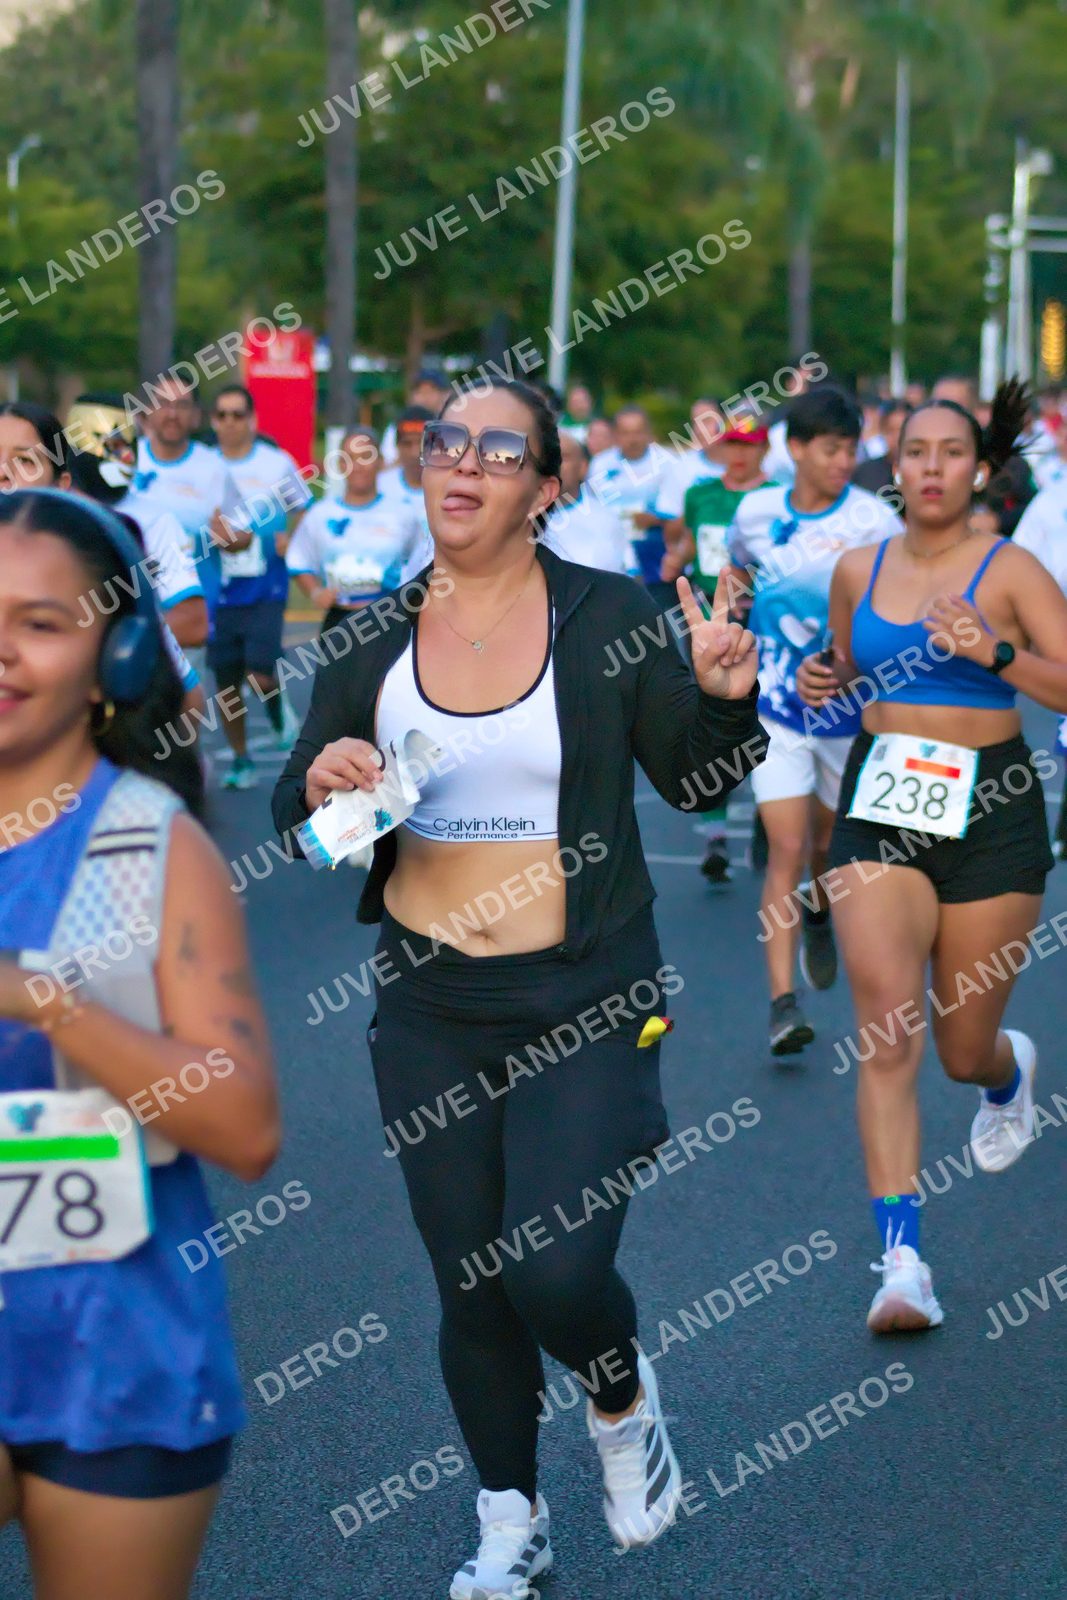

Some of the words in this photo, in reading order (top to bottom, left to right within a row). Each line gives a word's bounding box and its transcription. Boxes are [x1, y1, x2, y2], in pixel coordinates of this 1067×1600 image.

[870, 772, 948, 820] 238
[434, 818, 488, 832] Calvin
[492, 817, 535, 831] Klein
[447, 832, 518, 840] Performance
